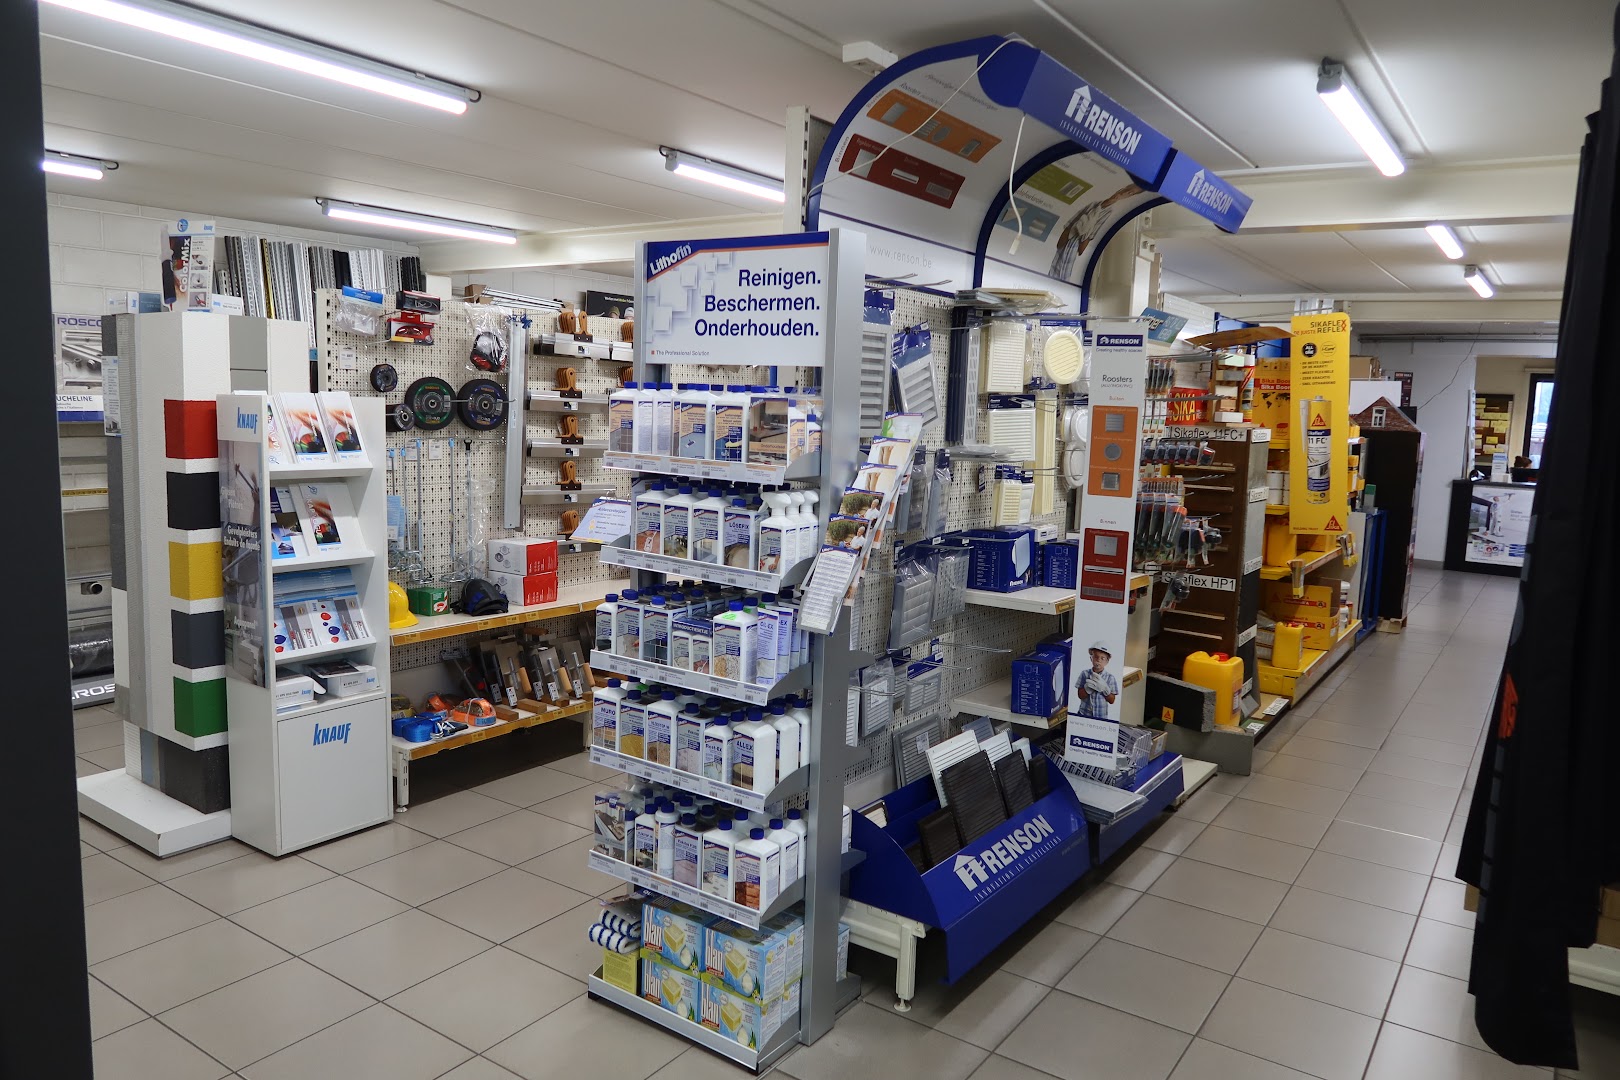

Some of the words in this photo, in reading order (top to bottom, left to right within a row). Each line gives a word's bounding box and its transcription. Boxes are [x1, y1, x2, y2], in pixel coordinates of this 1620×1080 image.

[1084, 103, 1142, 156] RENSON
[1199, 181, 1233, 215] RENSON
[179, 238, 191, 293] ColorMix
[649, 242, 692, 275] Lithofin
[869, 245, 932, 268] www.renson.be
[738, 267, 821, 290] Reinigen.
[704, 294, 820, 312] Beschermen.
[694, 318, 819, 336] Onderhouden.
[1310, 319, 1347, 328] SIKAFLEX
[1317, 326, 1346, 334] REFLEX
[1102, 374, 1133, 383] Roosters
[1173, 426, 1210, 439] Sikaflex
[1164, 572, 1207, 587] Saflex
[1211, 577, 1234, 590] HP1
[1069, 720, 1117, 733] www.renson.be
[1069, 747, 1085, 755] Creating
[1085, 749, 1099, 758] healthy
[1099, 752, 1113, 760] spaces
[1082, 740, 1110, 751] RENSON
[980, 814, 1055, 875] RENSON
